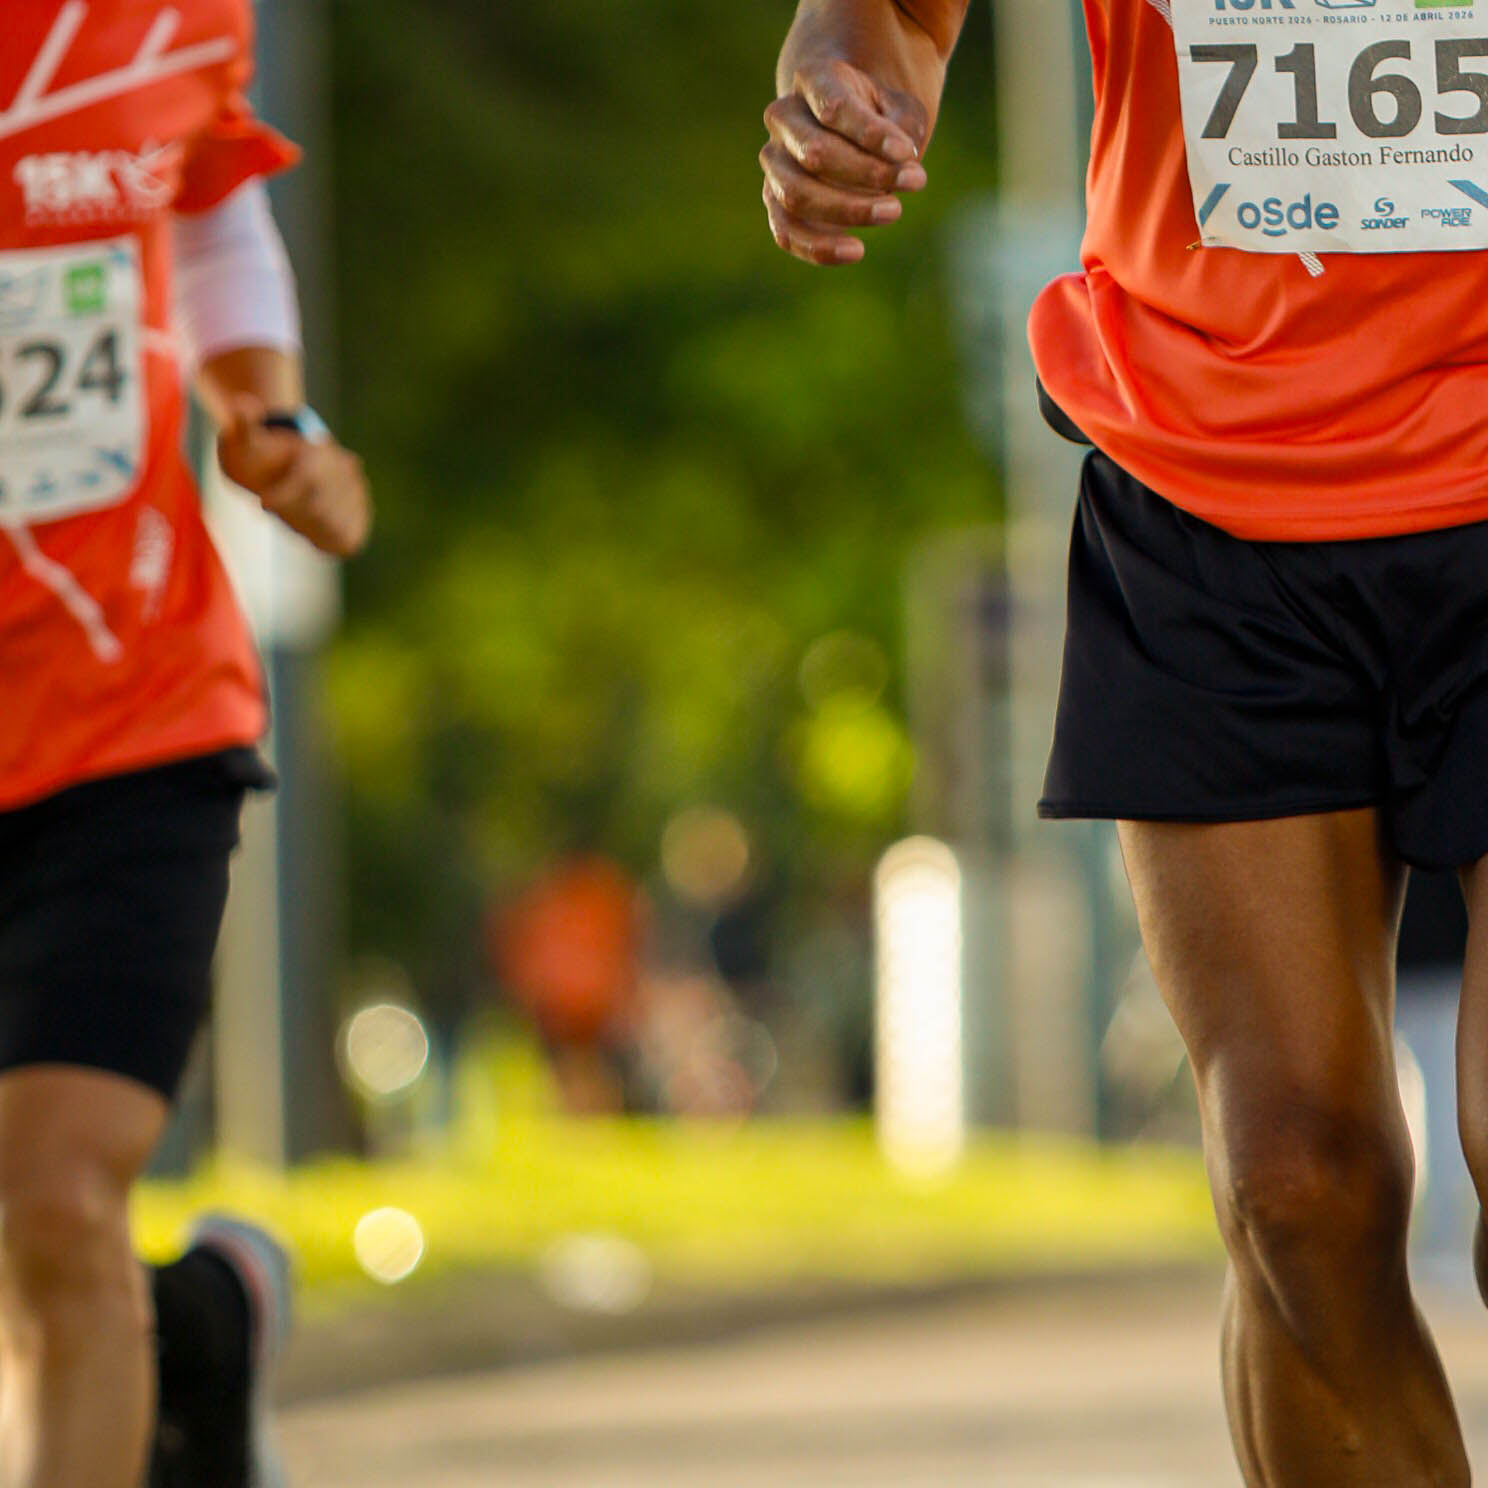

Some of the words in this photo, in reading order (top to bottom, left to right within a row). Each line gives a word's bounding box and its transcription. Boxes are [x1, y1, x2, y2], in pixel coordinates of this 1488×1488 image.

[1208, 15, 1249, 25] PUERTO
[1251, 16, 1285, 25] NORTE
[1323, 15, 1368, 24] ROSARIO
[1380, 14, 1392, 22] 12
[1395, 13, 1409, 22] DE
[1413, 11, 1444, 21] ABRIL
[1227, 146, 1300, 167] Castillo
[1305, 146, 1373, 167] Gaston
[1380, 143, 1474, 165] Fernando
[1236, 192, 1340, 230] osde
[1420, 207, 1473, 219] POWER
[0, 327, 126, 418] 24
